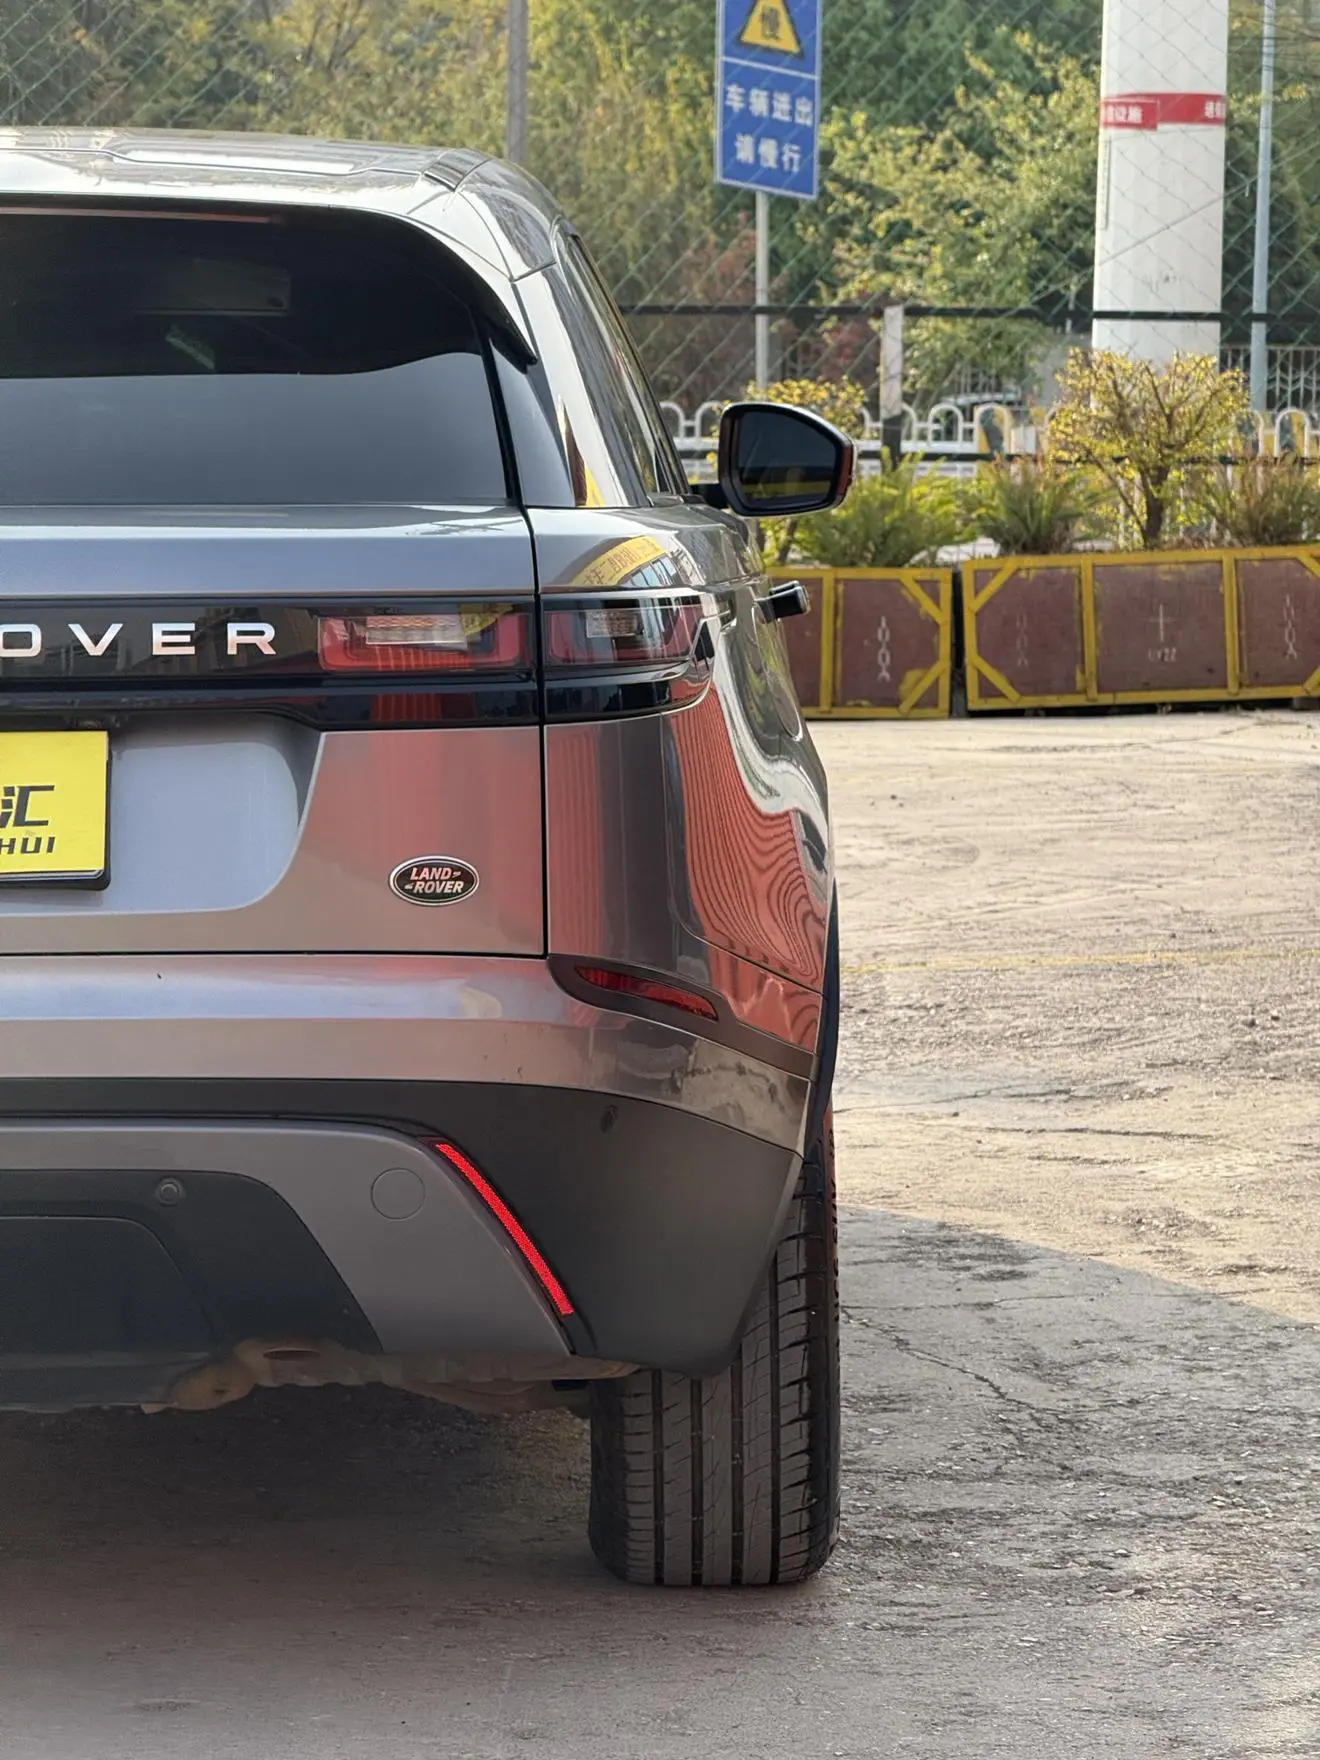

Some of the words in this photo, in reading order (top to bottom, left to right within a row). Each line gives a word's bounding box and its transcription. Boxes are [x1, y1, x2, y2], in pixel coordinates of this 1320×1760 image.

[725, 83, 813, 127] 车辆进出
[0, 623, 276, 657] OVER
[410, 867, 452, 880] LAND
[413, 881, 464, 893] ROVER
